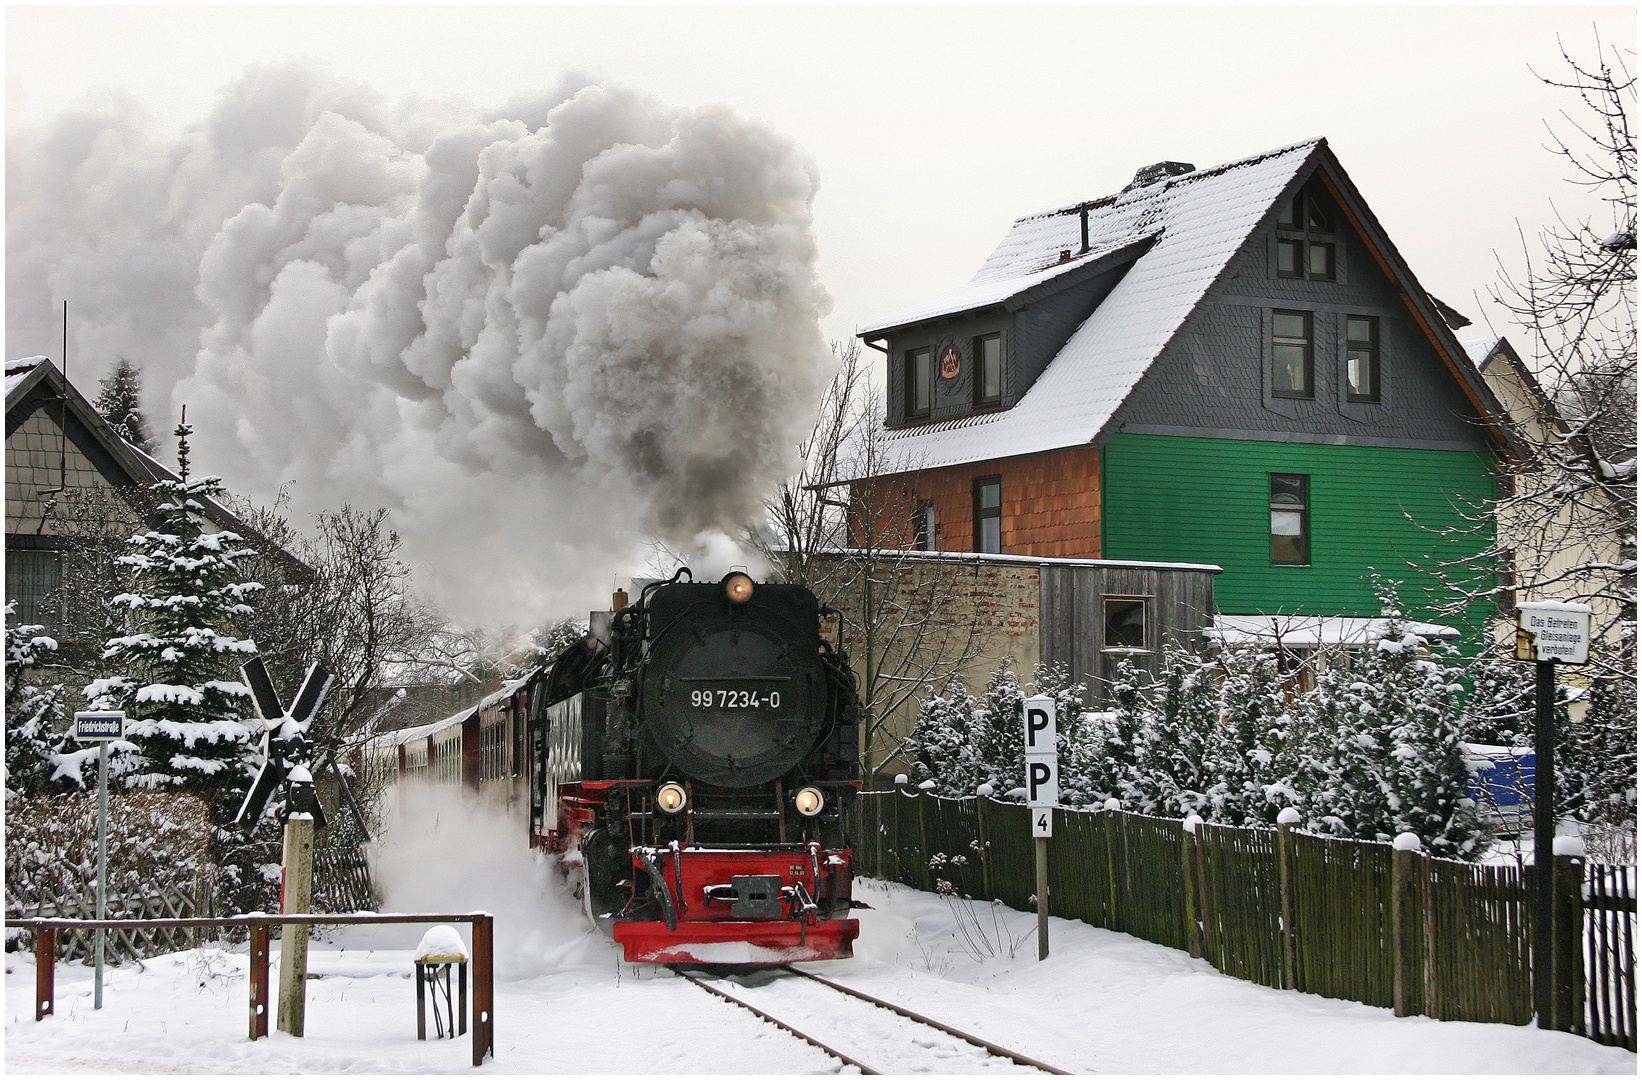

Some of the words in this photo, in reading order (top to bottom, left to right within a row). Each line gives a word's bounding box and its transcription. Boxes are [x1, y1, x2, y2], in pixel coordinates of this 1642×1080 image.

[1531, 615, 1545, 627] Das
[1547, 616, 1578, 629] Betreten
[1541, 629, 1582, 644] Gleisanlage
[1541, 644, 1576, 656] verboten!
[691, 690, 713, 707] 99
[717, 690, 780, 708] 7234-0
[78, 720, 120, 734] Friedrichstraße
[1027, 708, 1049, 747] P
[1029, 762, 1051, 801] P
[1037, 813, 1048, 832] 4
